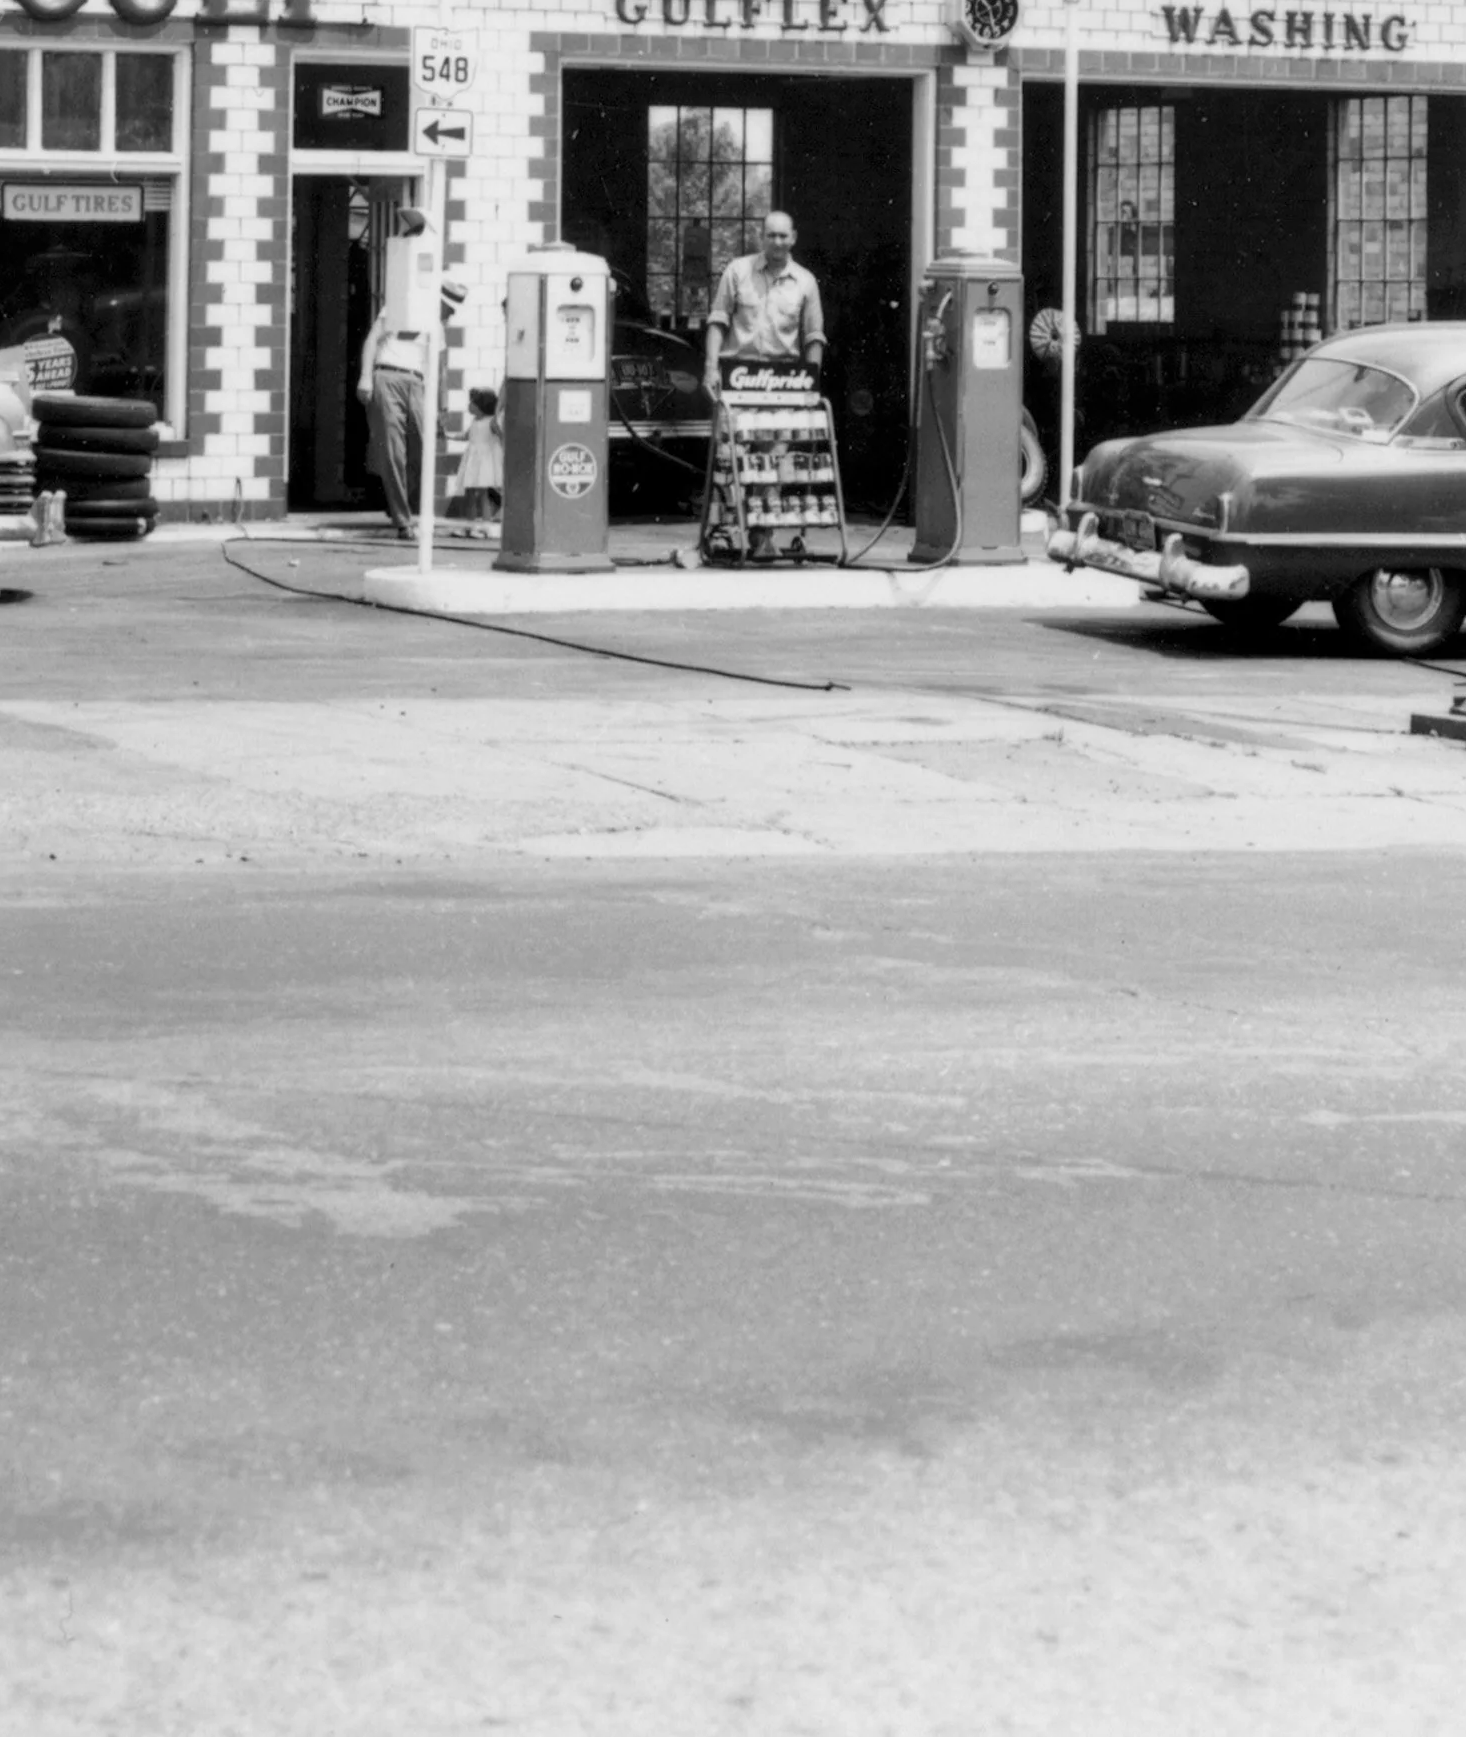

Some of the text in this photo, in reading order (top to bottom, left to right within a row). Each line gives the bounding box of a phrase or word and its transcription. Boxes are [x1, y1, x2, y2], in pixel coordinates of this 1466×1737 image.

[1161, 4, 1411, 53] WASHING
[431, 37, 462, 51] OHIO
[421, 55, 469, 83] 548
[326, 96, 377, 107] CHAMPION
[12, 194, 134, 213] GULF TIRES
[730, 366, 814, 392] Gulfpride
